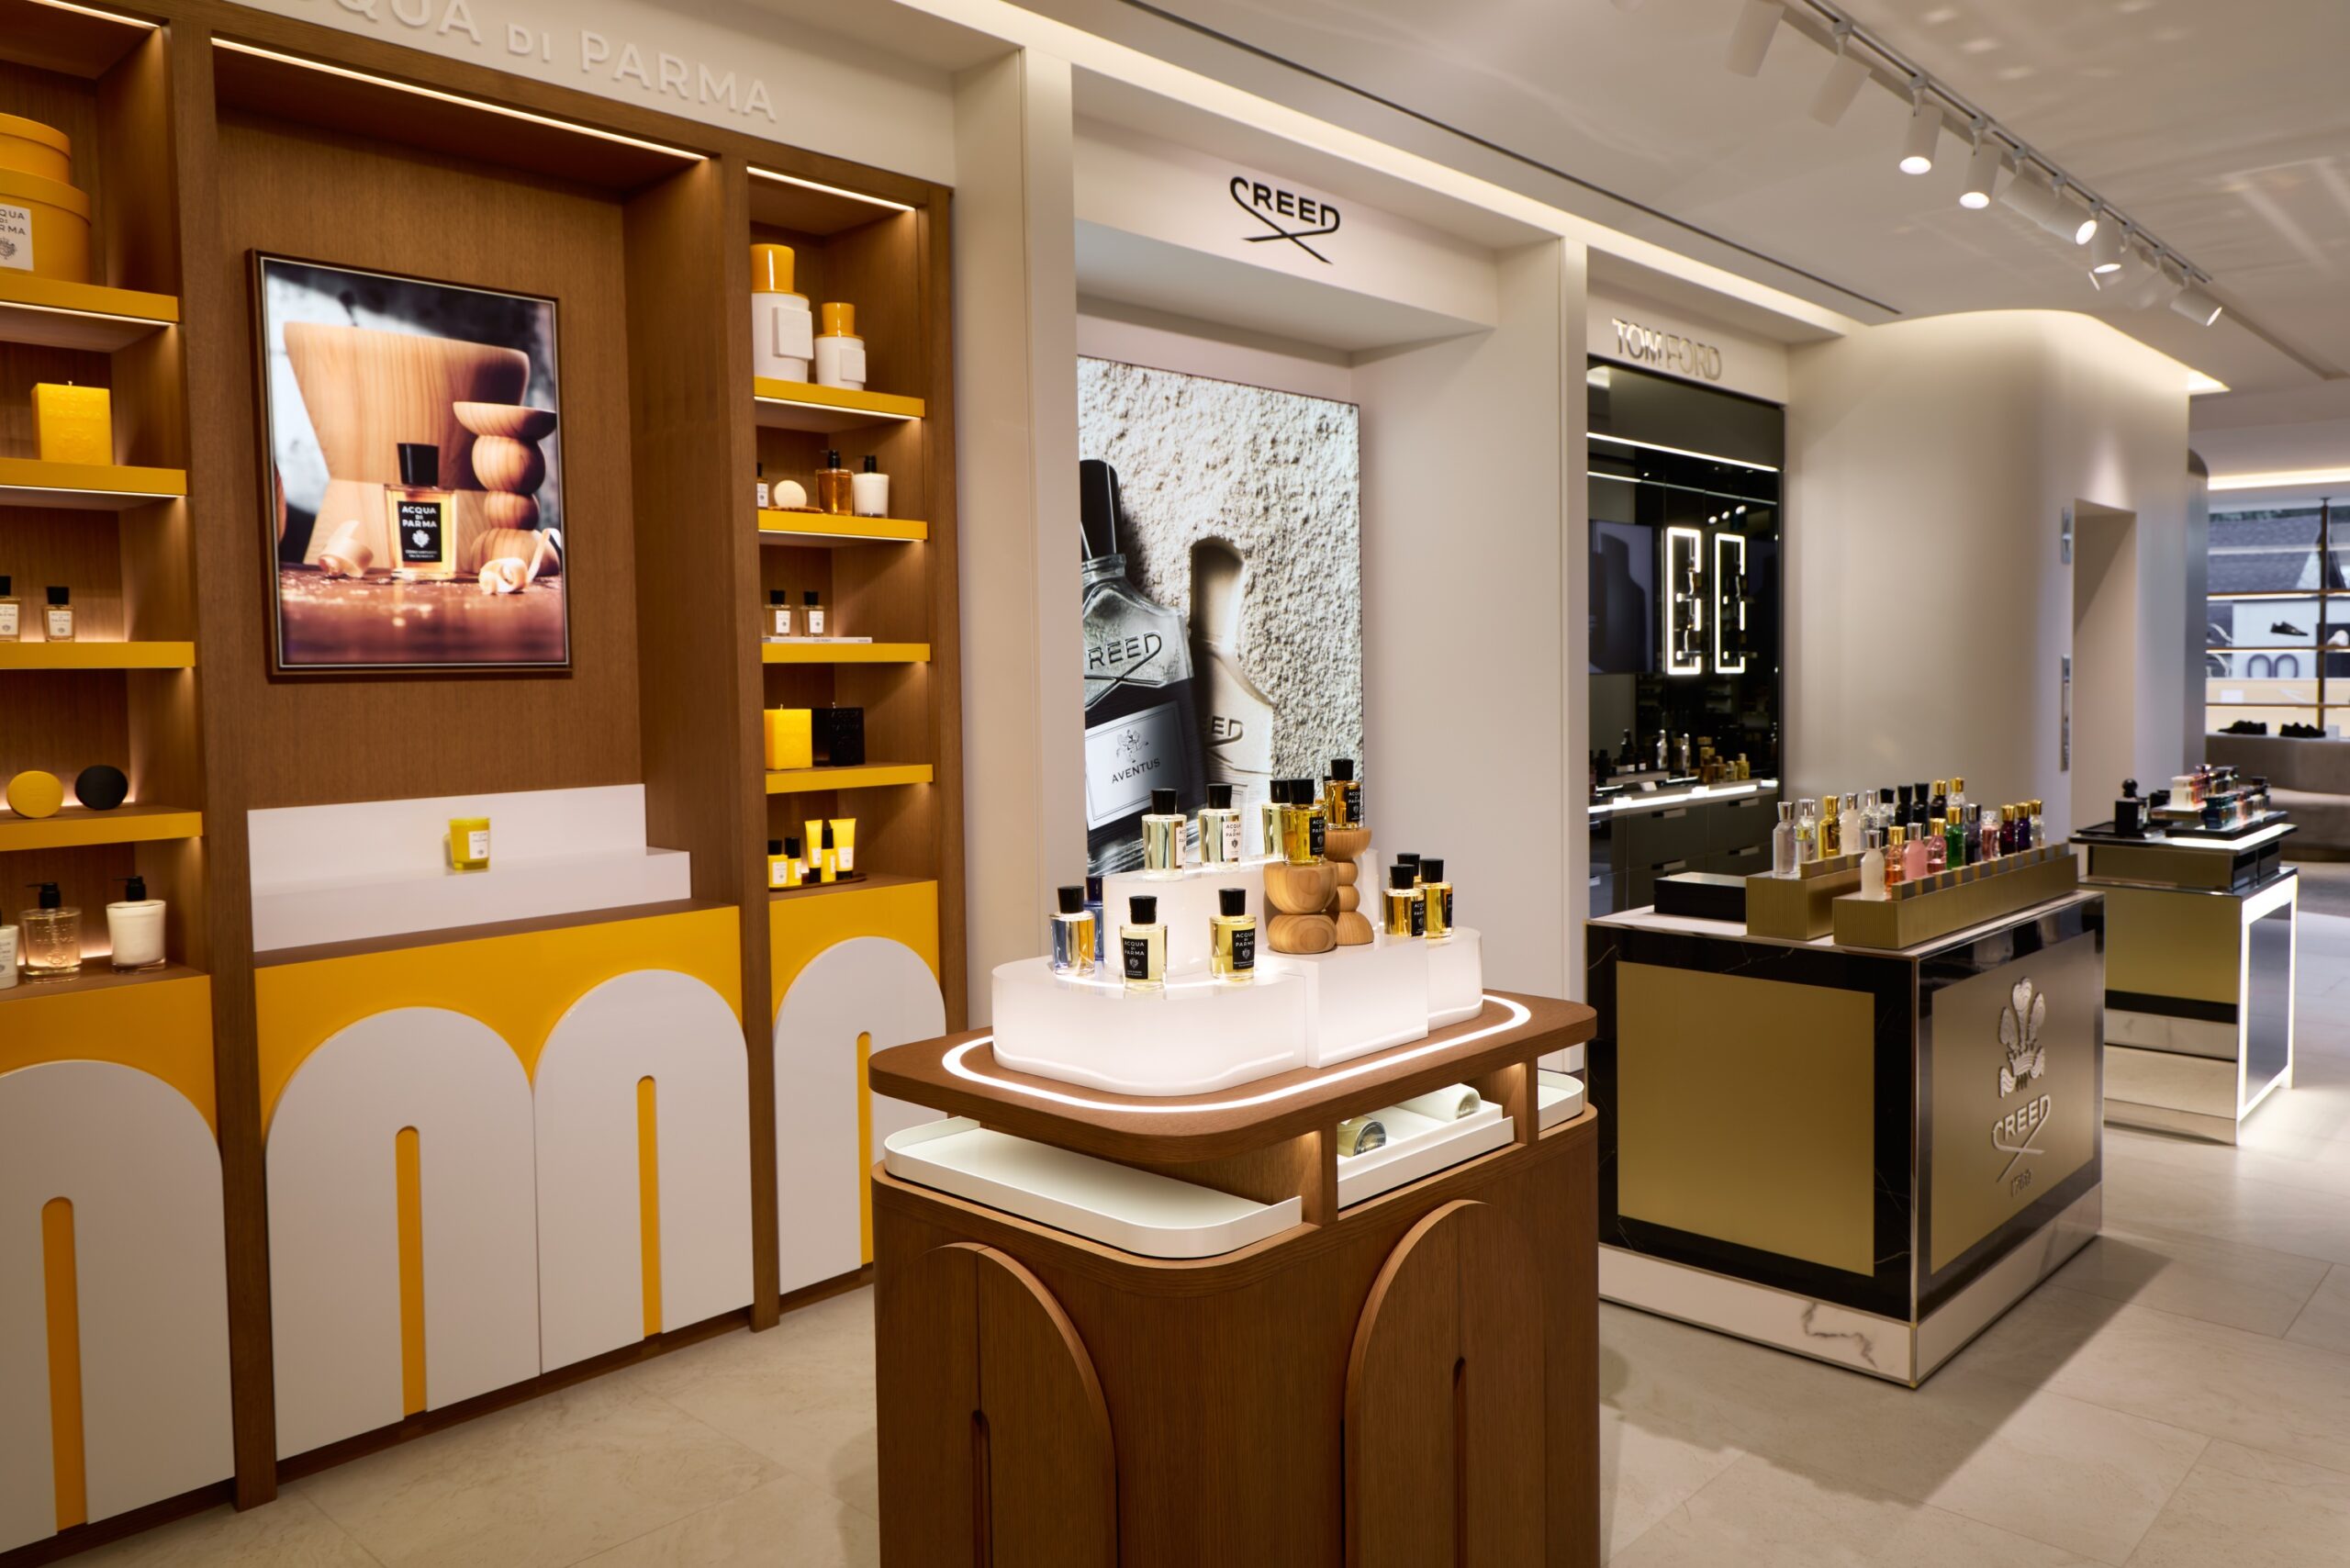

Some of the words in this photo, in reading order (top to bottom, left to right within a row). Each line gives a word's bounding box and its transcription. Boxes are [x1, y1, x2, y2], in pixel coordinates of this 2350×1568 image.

[507, 24, 551, 62] DI
[580, 29, 778, 123] PARMA
[1229, 176, 1340, 264] CREED
[1612, 317, 1662, 366] TOM
[1665, 333, 1723, 381] FORD
[401, 506, 437, 515] ACQUA
[401, 519, 438, 528] PARMA
[1111, 757, 1161, 784] AVENTUS
[1991, 1093, 2052, 1183] CREED
